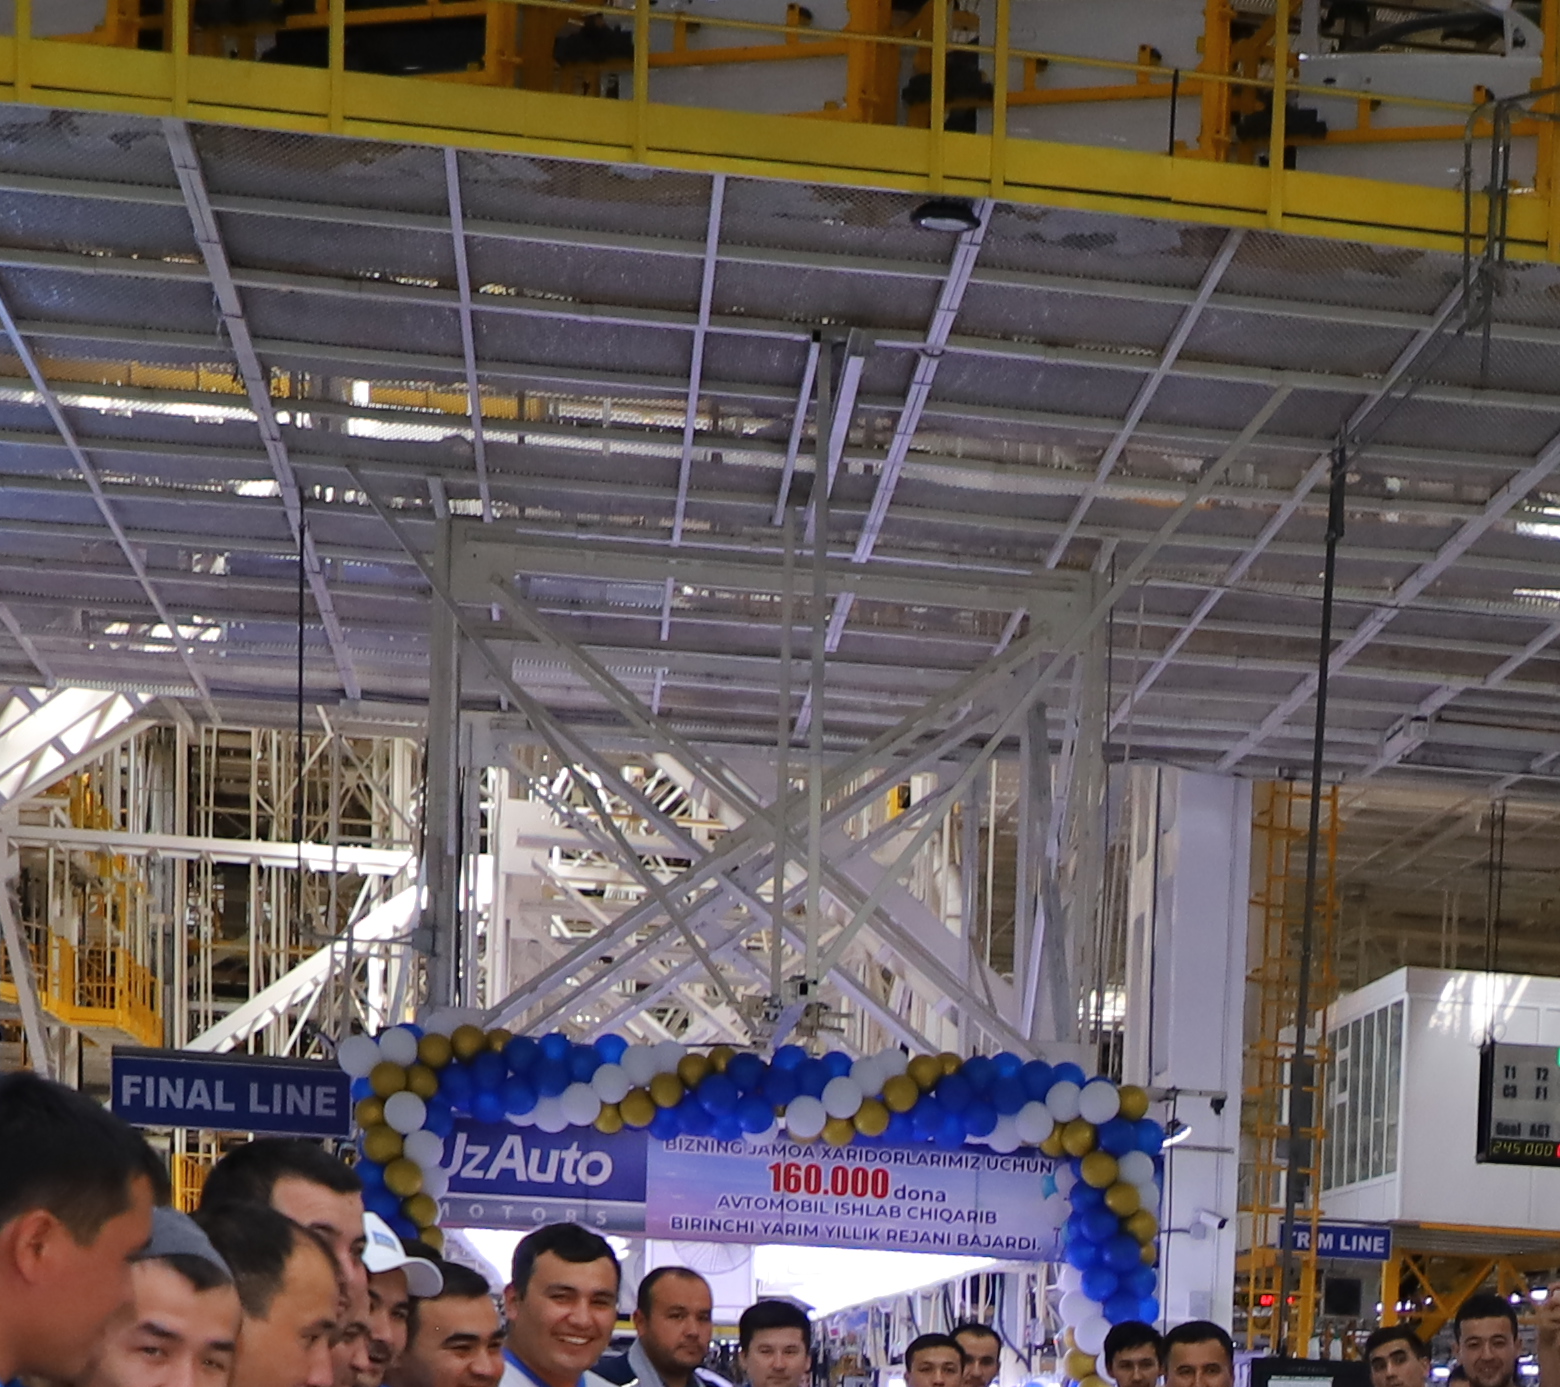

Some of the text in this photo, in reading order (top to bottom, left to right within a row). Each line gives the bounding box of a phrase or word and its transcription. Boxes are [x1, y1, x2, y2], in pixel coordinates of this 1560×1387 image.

[1504, 1065, 1516, 1079] T1
[1536, 1067, 1549, 1081] T2
[121, 1074, 337, 1117] FINAL LINE
[1536, 1087, 1548, 1100] F1
[664, 1137, 1053, 1174] BIZNING JAMOA XARIDORLARIMIZ UCHUN
[768, 1162, 947, 1203] 160.000 dona
[717, 1195, 997, 1225] AVTOMOBIL ISHLAB CHIQARIB
[670, 1215, 1042, 1252] BIRINCHI YARIM YILLIK REJANI BAJARDI.
[1292, 1231, 1385, 1253] RM LINE
